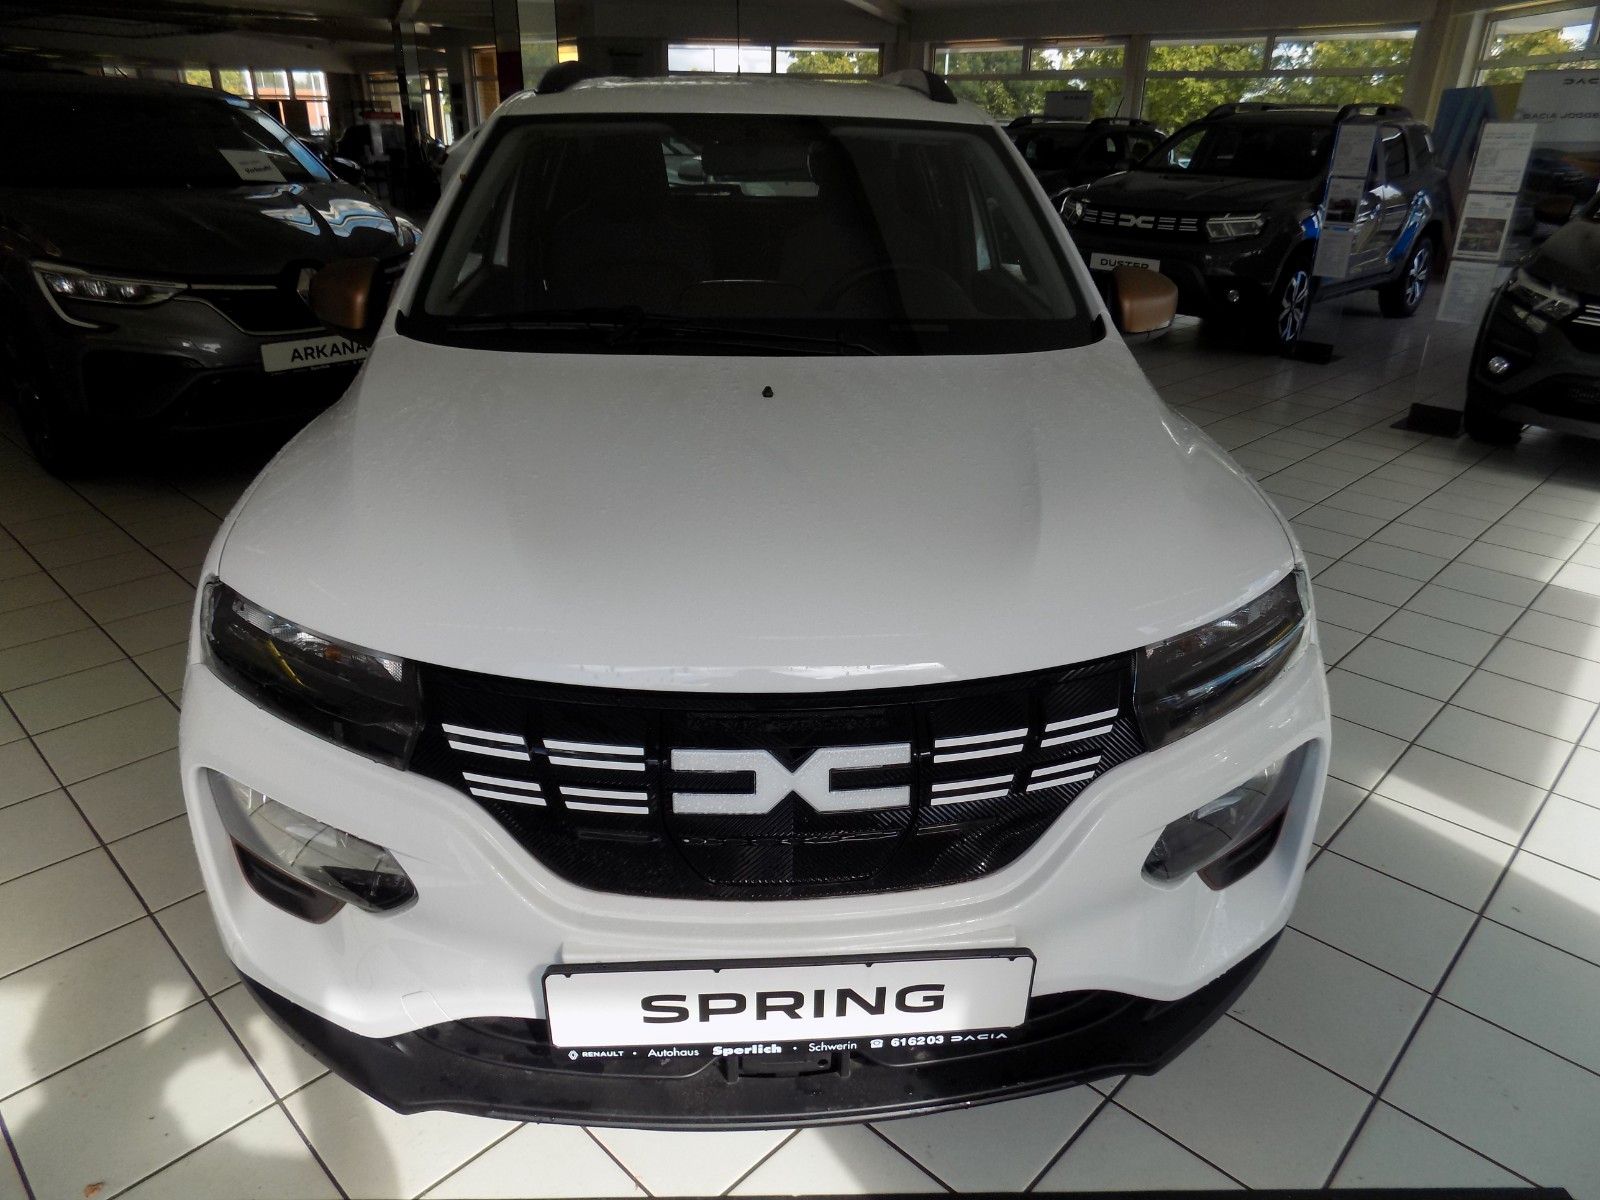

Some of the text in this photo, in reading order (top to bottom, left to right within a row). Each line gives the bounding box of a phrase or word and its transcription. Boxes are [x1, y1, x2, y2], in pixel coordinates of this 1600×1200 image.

[640, 983, 945, 1024] SPRING
[582, 1033, 1008, 1058] RENAULT Autohaus Sperlich Schwerin 616203 DACIA
